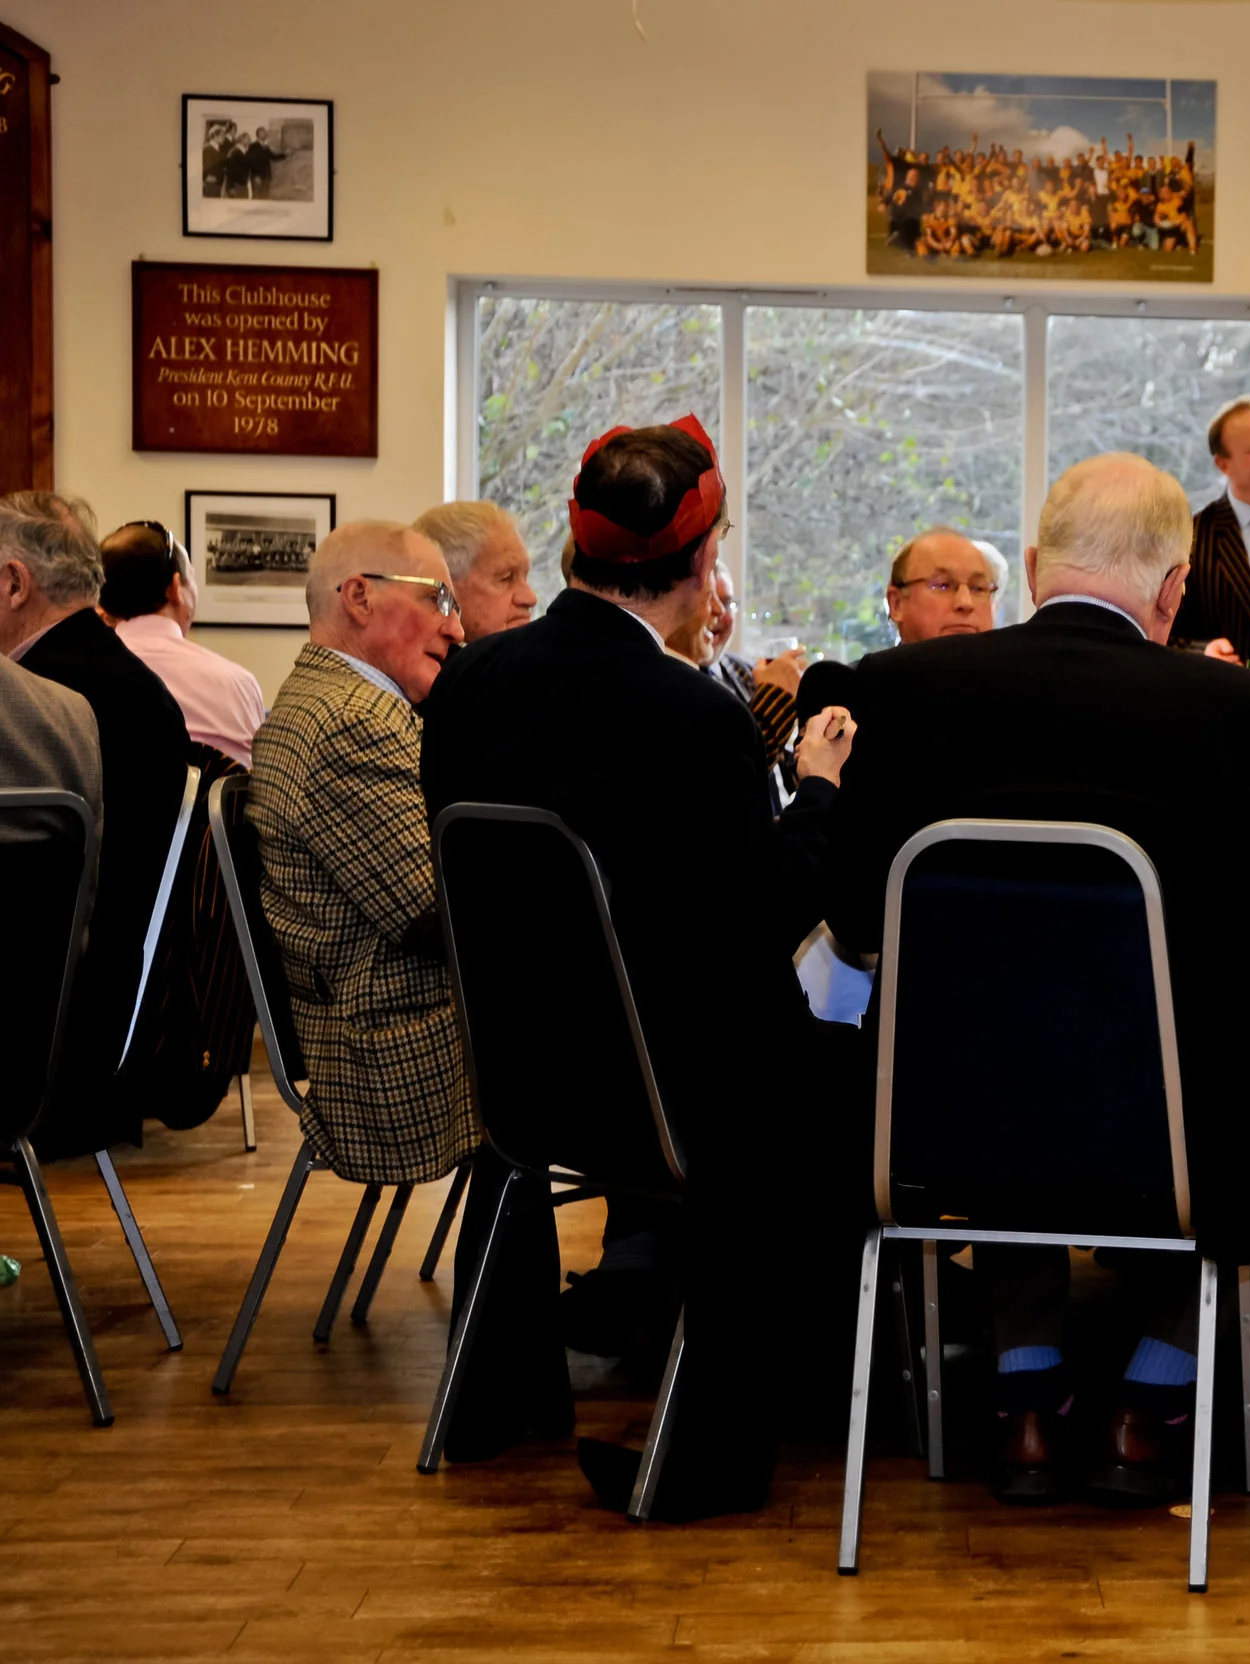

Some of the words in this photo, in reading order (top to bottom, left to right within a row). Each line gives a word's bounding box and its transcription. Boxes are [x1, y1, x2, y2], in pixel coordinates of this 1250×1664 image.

[178, 284, 221, 304] This
[226, 286, 331, 308] Clubhouse
[185, 312, 221, 328] was
[226, 311, 298, 333] opened
[304, 311, 328, 335] by
[148, 336, 216, 360] ALEX
[226, 338, 359, 365] HEMMING
[158, 367, 223, 384] President
[226, 369, 258, 387] Kent
[262, 370, 312, 391] County
[173, 391, 200, 408] on
[207, 389, 228, 408] 10
[235, 391, 340, 413] September
[233, 416, 278, 436] 1978
